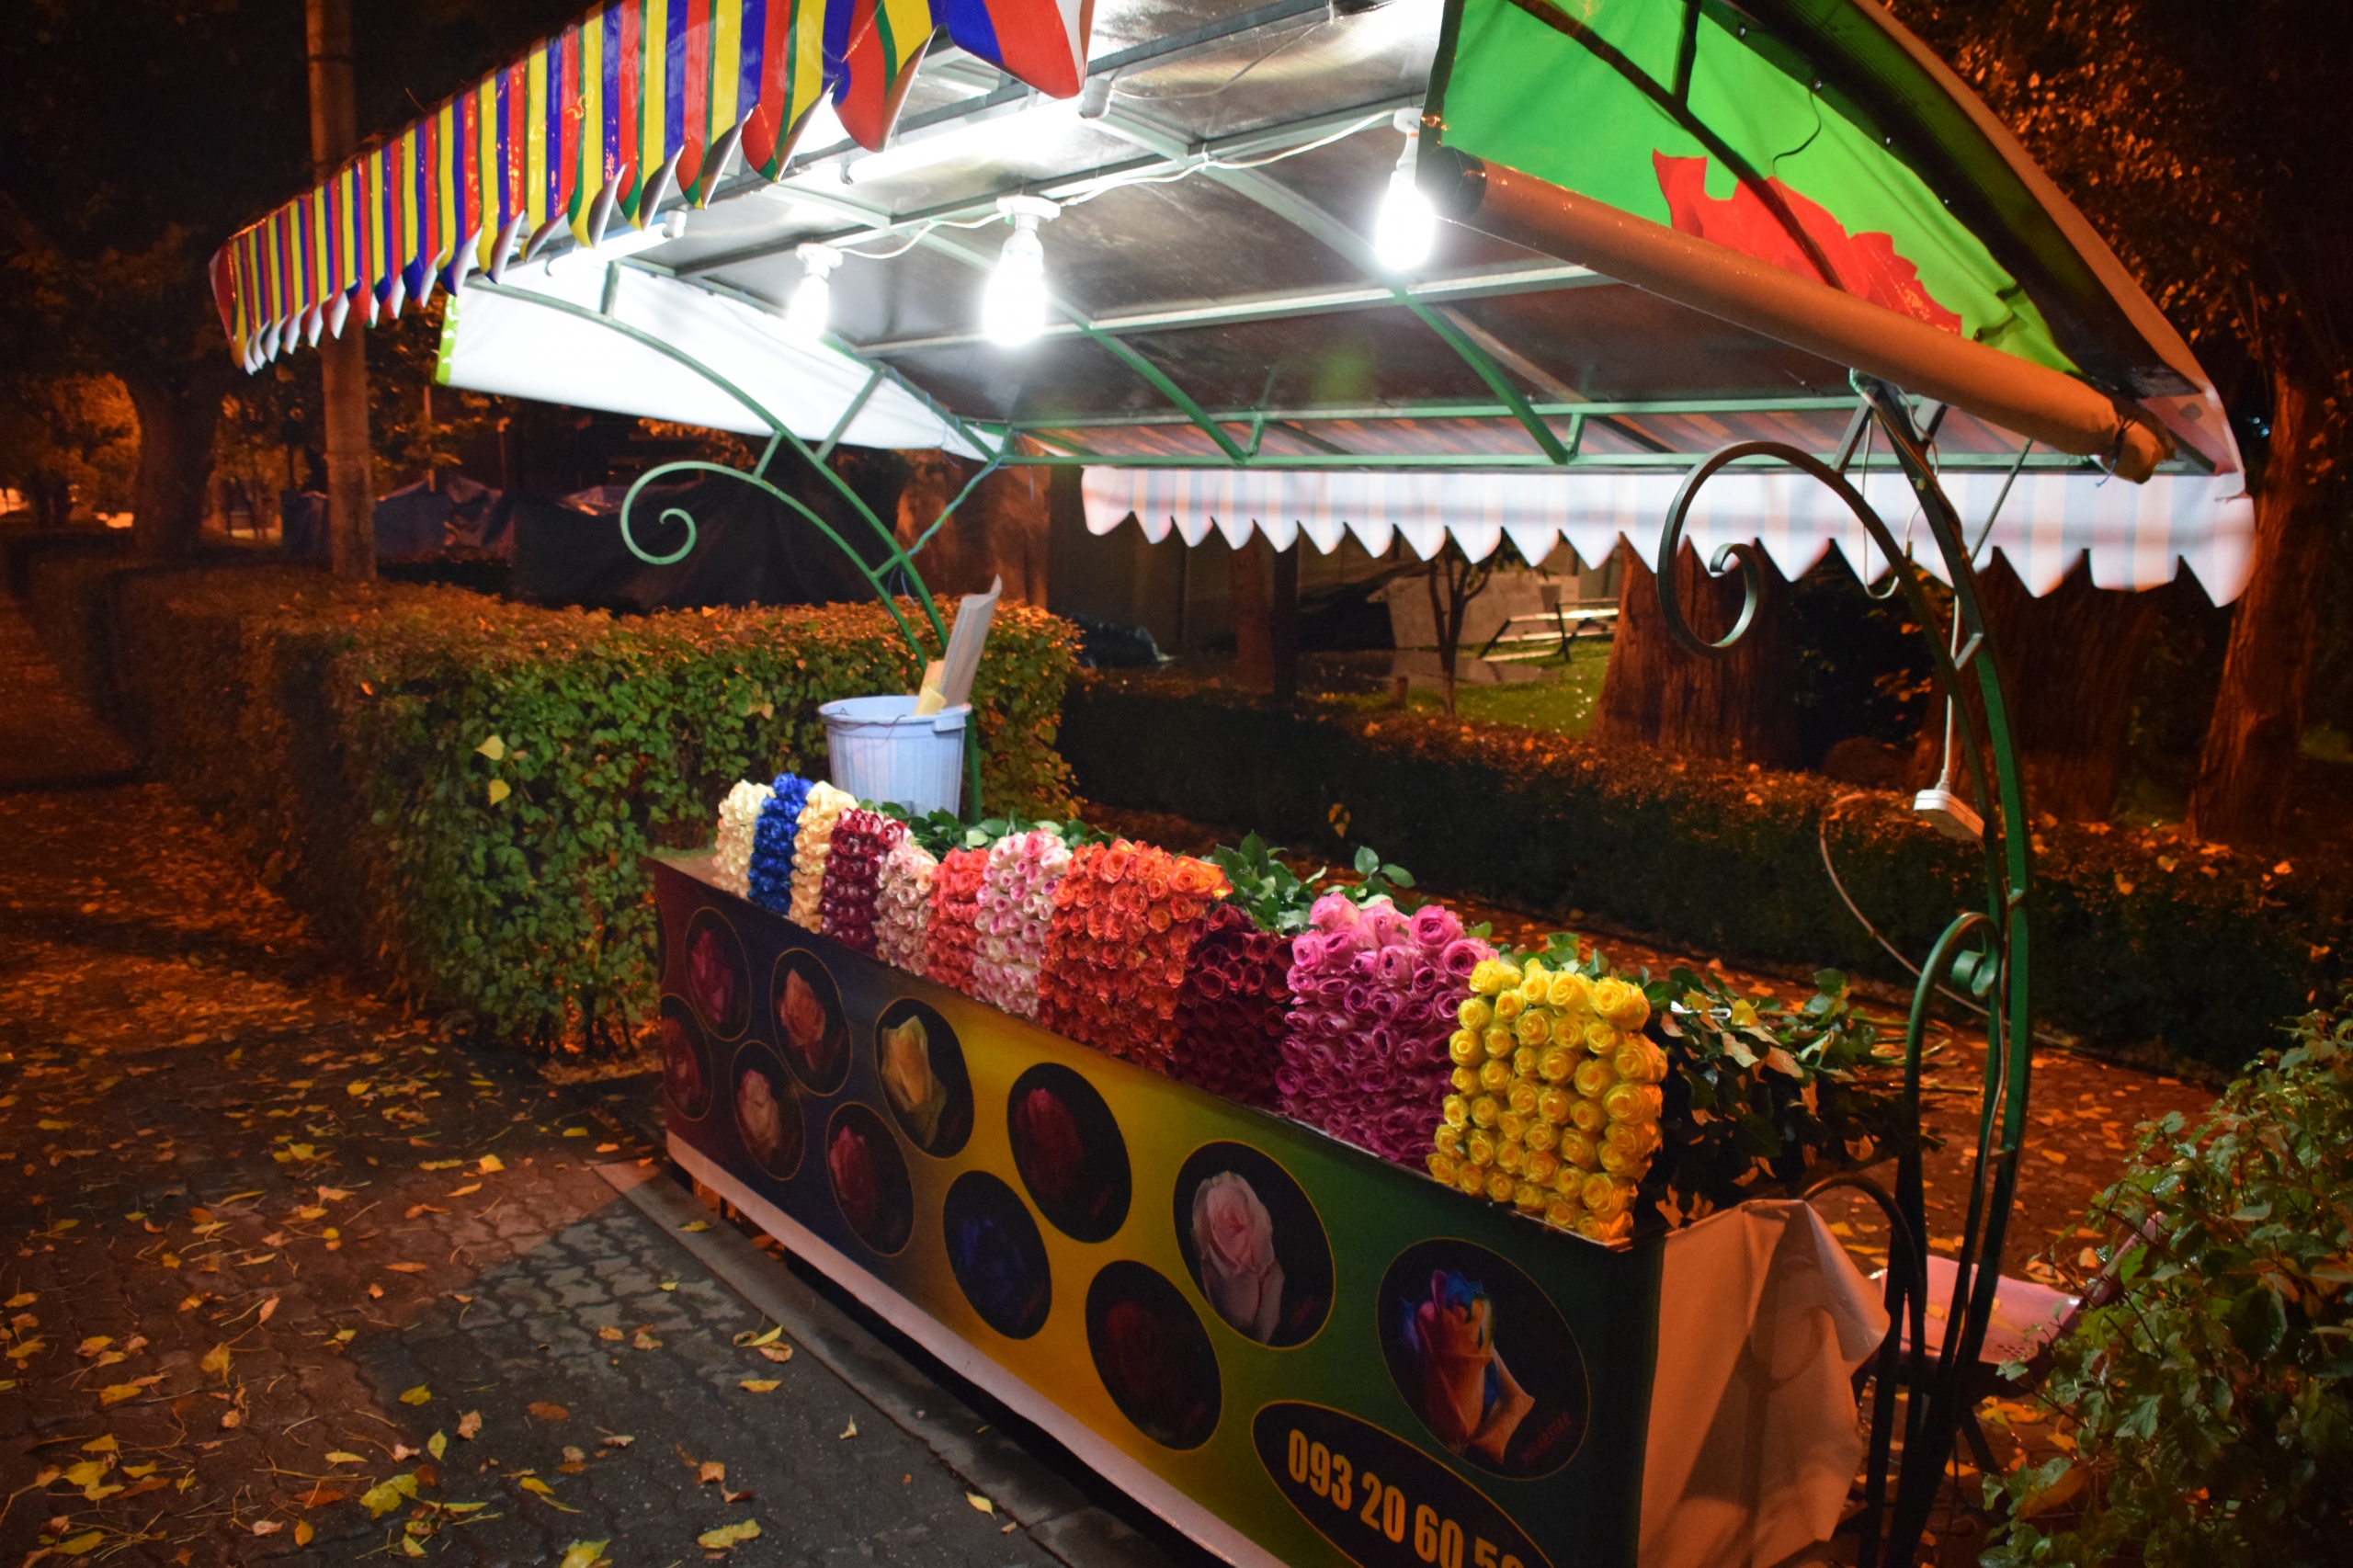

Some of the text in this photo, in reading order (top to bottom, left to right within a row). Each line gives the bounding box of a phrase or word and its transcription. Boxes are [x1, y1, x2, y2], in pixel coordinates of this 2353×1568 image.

[1288, 1428, 1527, 1568] 093 20 60 5
